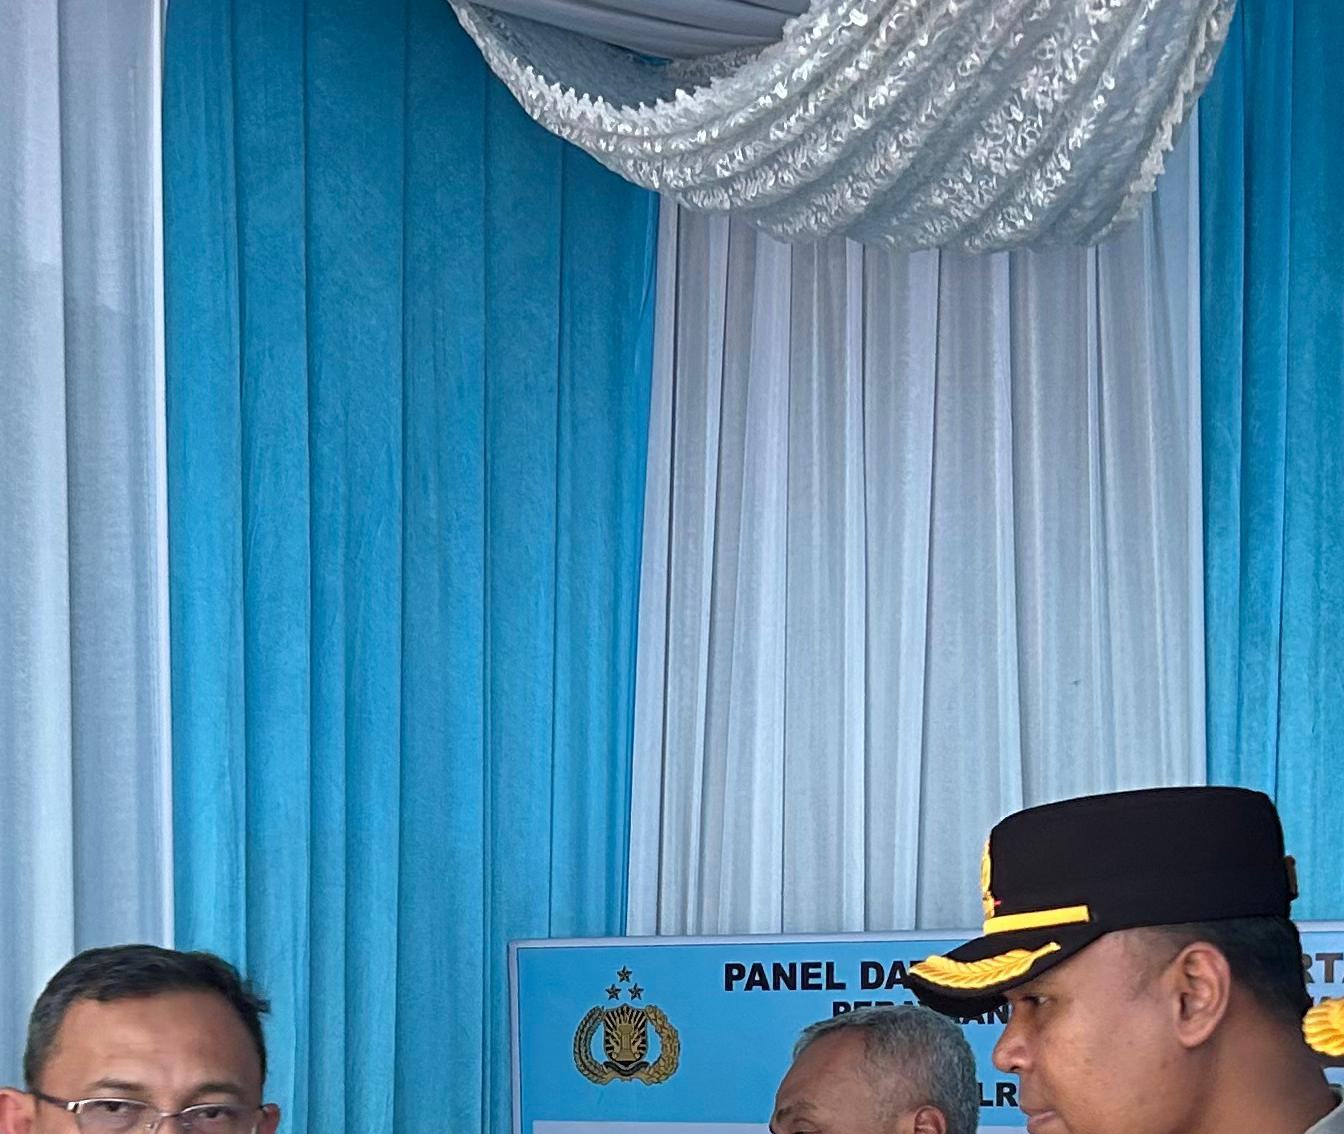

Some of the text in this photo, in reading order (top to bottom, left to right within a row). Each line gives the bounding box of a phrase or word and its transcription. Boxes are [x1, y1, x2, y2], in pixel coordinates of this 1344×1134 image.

[725, 962, 846, 991] PANEL
[860, 960, 918, 989] DA
[977, 1082, 1018, 1107] LR
